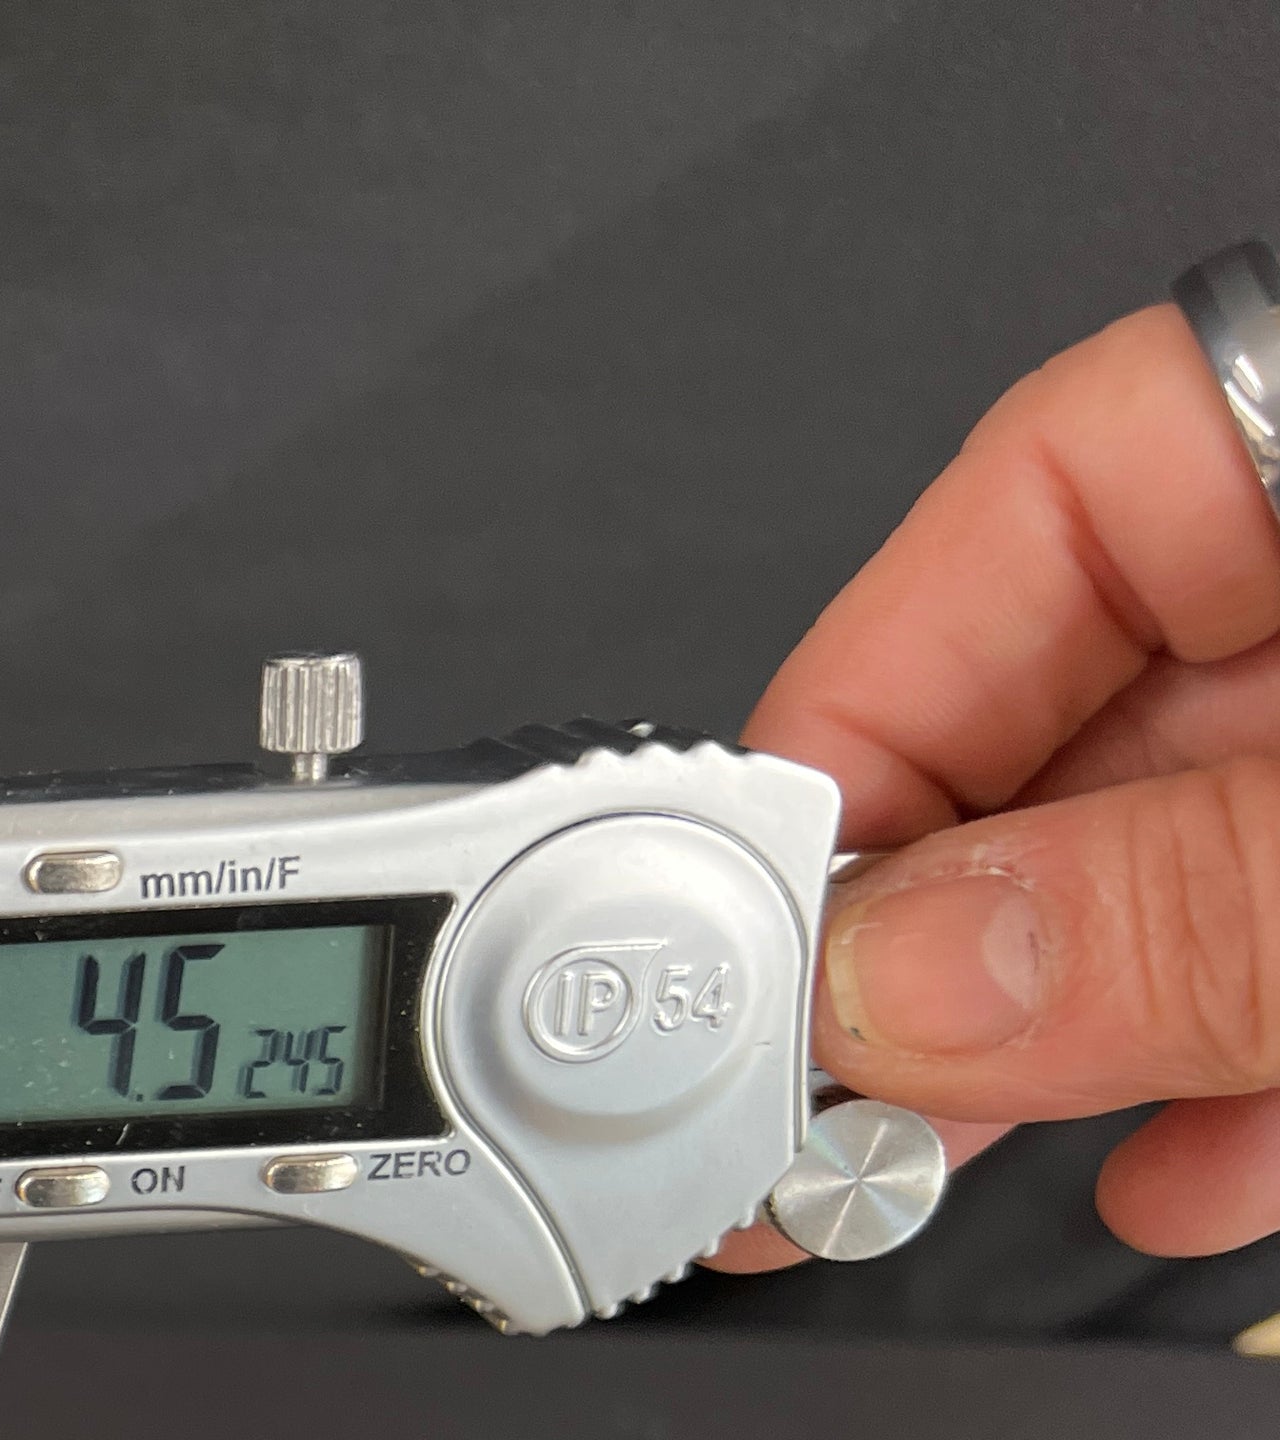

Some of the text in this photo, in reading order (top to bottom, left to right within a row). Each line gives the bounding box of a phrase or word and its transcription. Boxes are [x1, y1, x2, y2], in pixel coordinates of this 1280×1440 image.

[140, 855, 301, 898] mm/in/F
[553, 960, 735, 1037] IP 54
[130, 1165, 187, 1194] ON
[367, 1148, 472, 1181] ZERO
